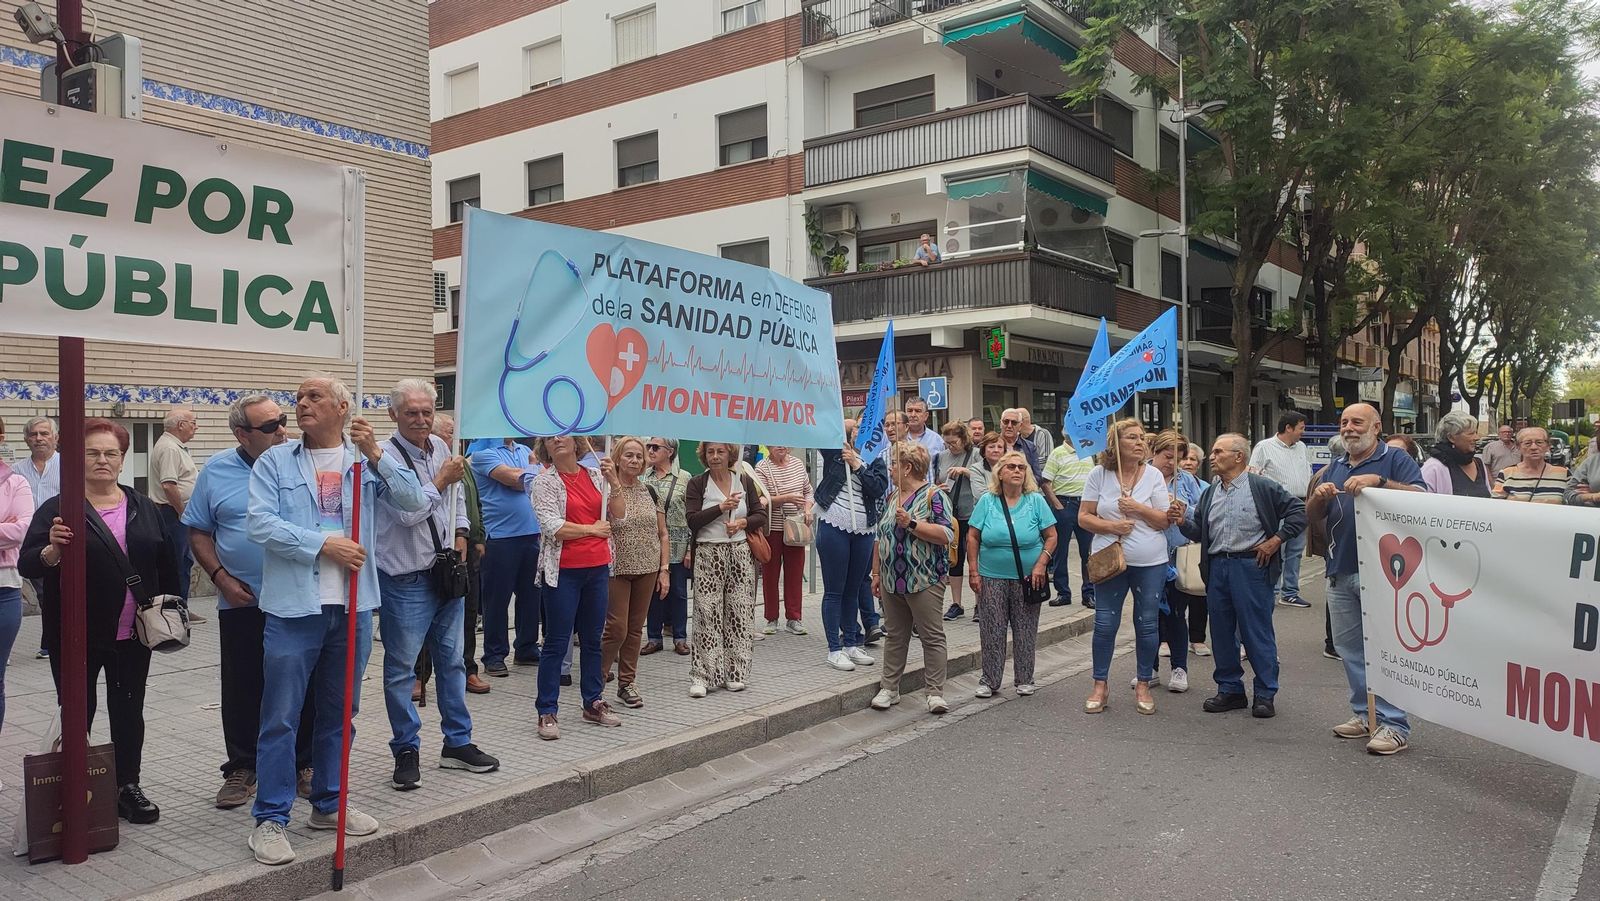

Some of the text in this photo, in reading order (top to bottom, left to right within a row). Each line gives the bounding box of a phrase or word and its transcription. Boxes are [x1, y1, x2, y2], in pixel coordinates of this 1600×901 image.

[0, 138, 294, 245] EZ POR
[0, 234, 339, 334] PÚBLICA
[591, 252, 818, 326] PLATAFORMA en DEFENSA
[640, 297, 752, 340] SANIDAD
[759, 317, 819, 356] PÚBLICA
[842, 357, 954, 384] ARACIA
[641, 384, 817, 426] MONTEMAYOR
[1375, 510, 1493, 533] PLATAFORMA EN DEFENSA
[1380, 649, 1479, 690] DE LA SANIDAD PÚBLICA
[1380, 666, 1482, 709] MONTALBÁN DE CÓRDOBA
[1506, 660, 1600, 744] MON
